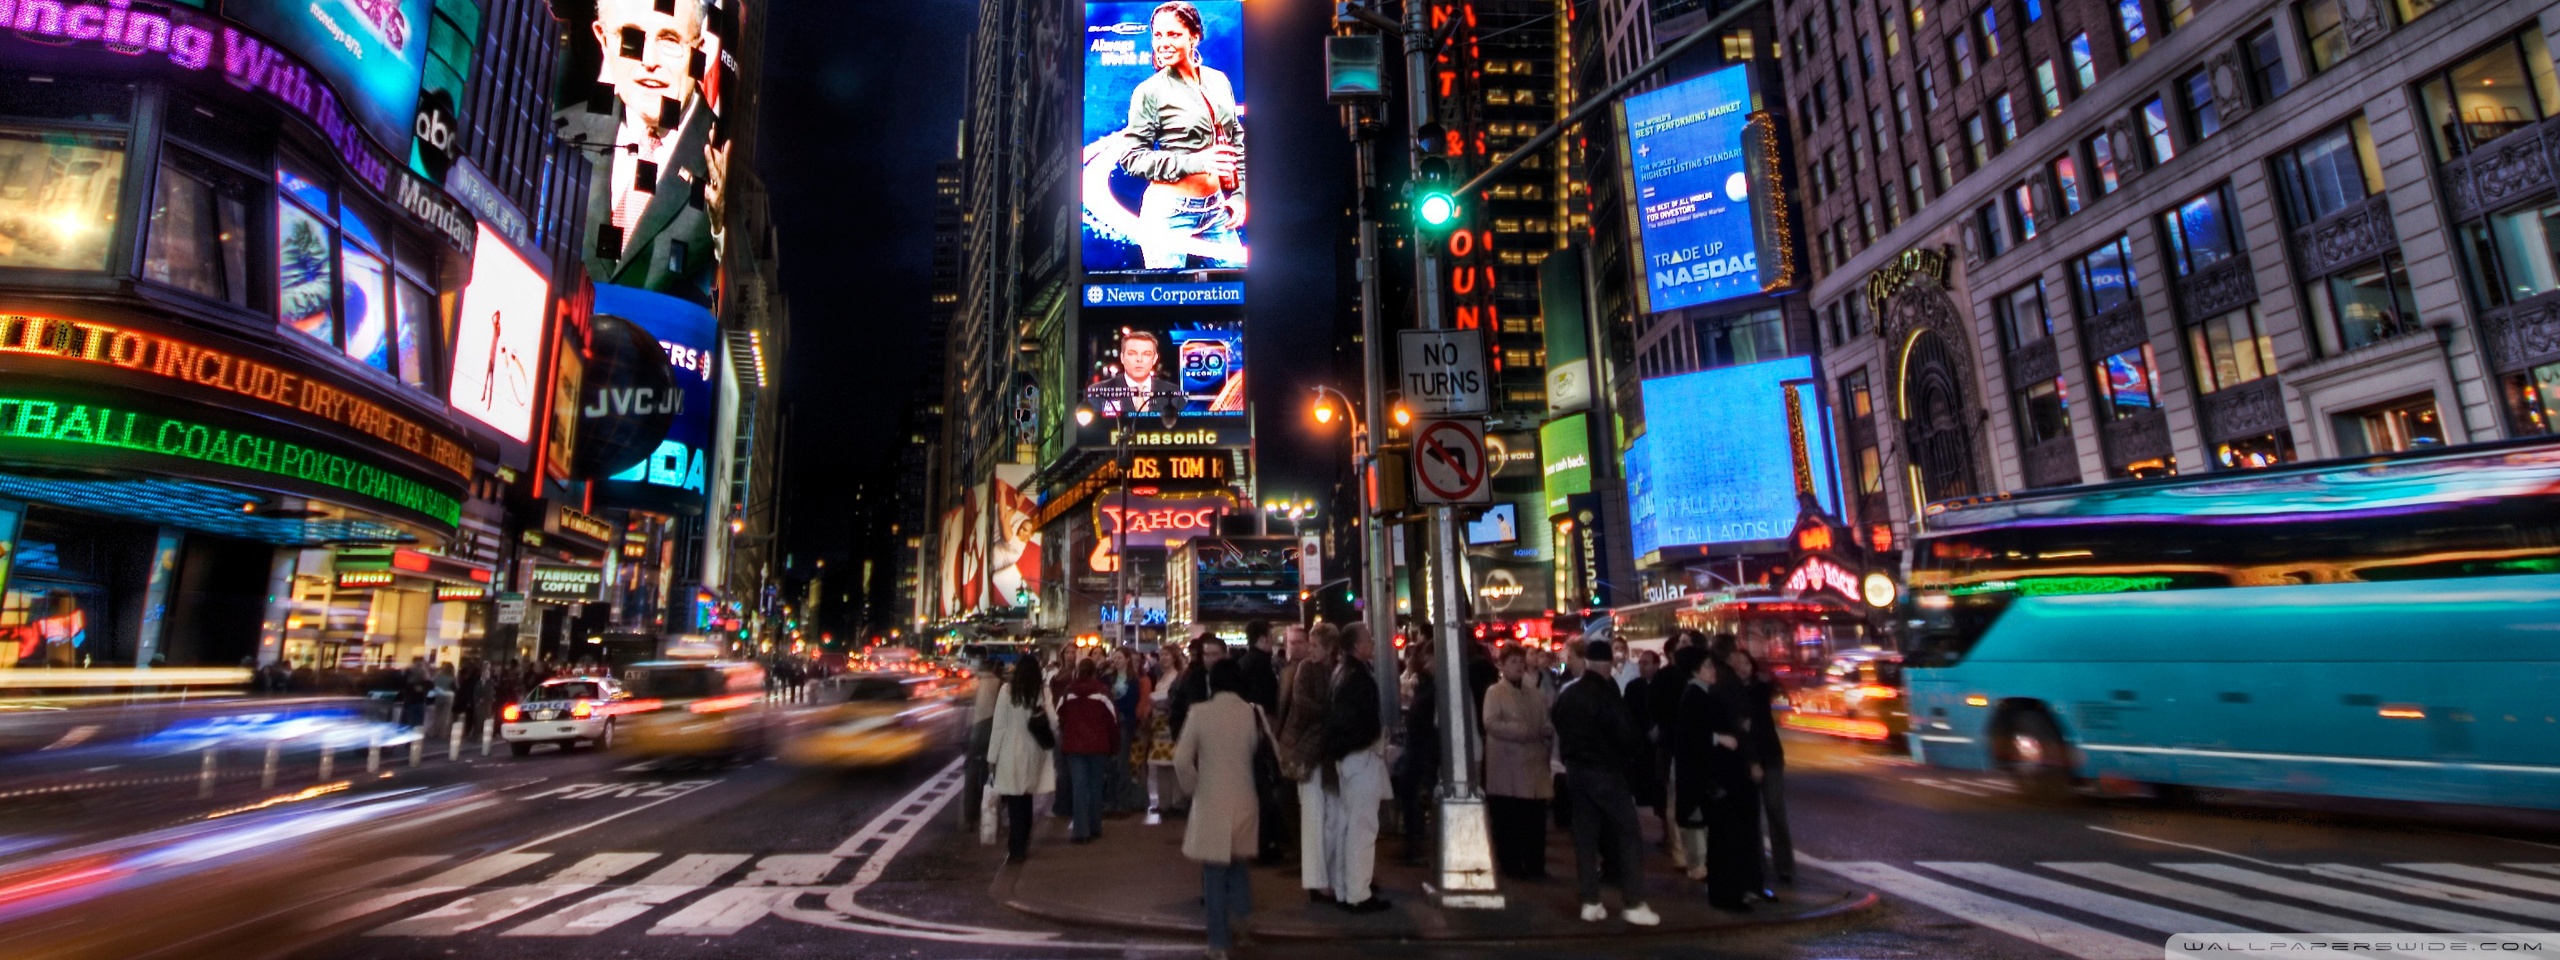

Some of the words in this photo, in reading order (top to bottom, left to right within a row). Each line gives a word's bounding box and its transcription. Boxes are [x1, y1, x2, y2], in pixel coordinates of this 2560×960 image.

[310, 2, 345, 43] mondays
[224, 27, 312, 114] With
[343, 123, 388, 192] Stars
[1635, 127, 1654, 139] BEST
[1656, 111, 1707, 133] PERFORMING
[1707, 101, 1742, 117] MARKET
[416, 109, 456, 159] abc
[1641, 166, 1672, 182] HIGHEST
[1673, 160, 1702, 174] LISTING
[397, 172, 472, 253] Mondays
[1647, 212, 1660, 223] FOR
[1660, 204, 1696, 220] INVESTORS
[1680, 198, 1689, 207] ALL
[1704, 241, 1724, 256] UP
[1106, 288, 1145, 302] News
[1151, 286, 1240, 305] Corporation
[1186, 353, 1223, 370] 80
[1423, 343, 1458, 366] NO
[1409, 371, 1480, 396] TURNS
[153, 339, 298, 406] INCLUDE
[299, 380, 346, 421] DRY
[347, 398, 423, 451] VARIETIES
[584, 388, 653, 418] JVC
[1110, 429, 1218, 446] Pnasonic
[156, 418, 274, 472] COACH
[281, 443, 357, 489] POKEY
[357, 464, 425, 512] CHATMAN
[1510, 452, 1535, 460] WORLD
[1169, 457, 1205, 478] TOM
[1665, 498, 1678, 519] IT
[1681, 494, 1709, 516] ALL
[1711, 490, 1754, 514] ADDS
[1668, 527, 1683, 545] IT
[1721, 520, 1769, 542] ADDS
[341, 571, 394, 586] SEPHORA
[532, 568, 600, 584] STARBUCKS
[1824, 562, 1860, 602] ROCK
[438, 587, 484, 600] SEPHORA
[541, 581, 588, 594] COFFEE
[520, 702, 571, 710] POLICE
